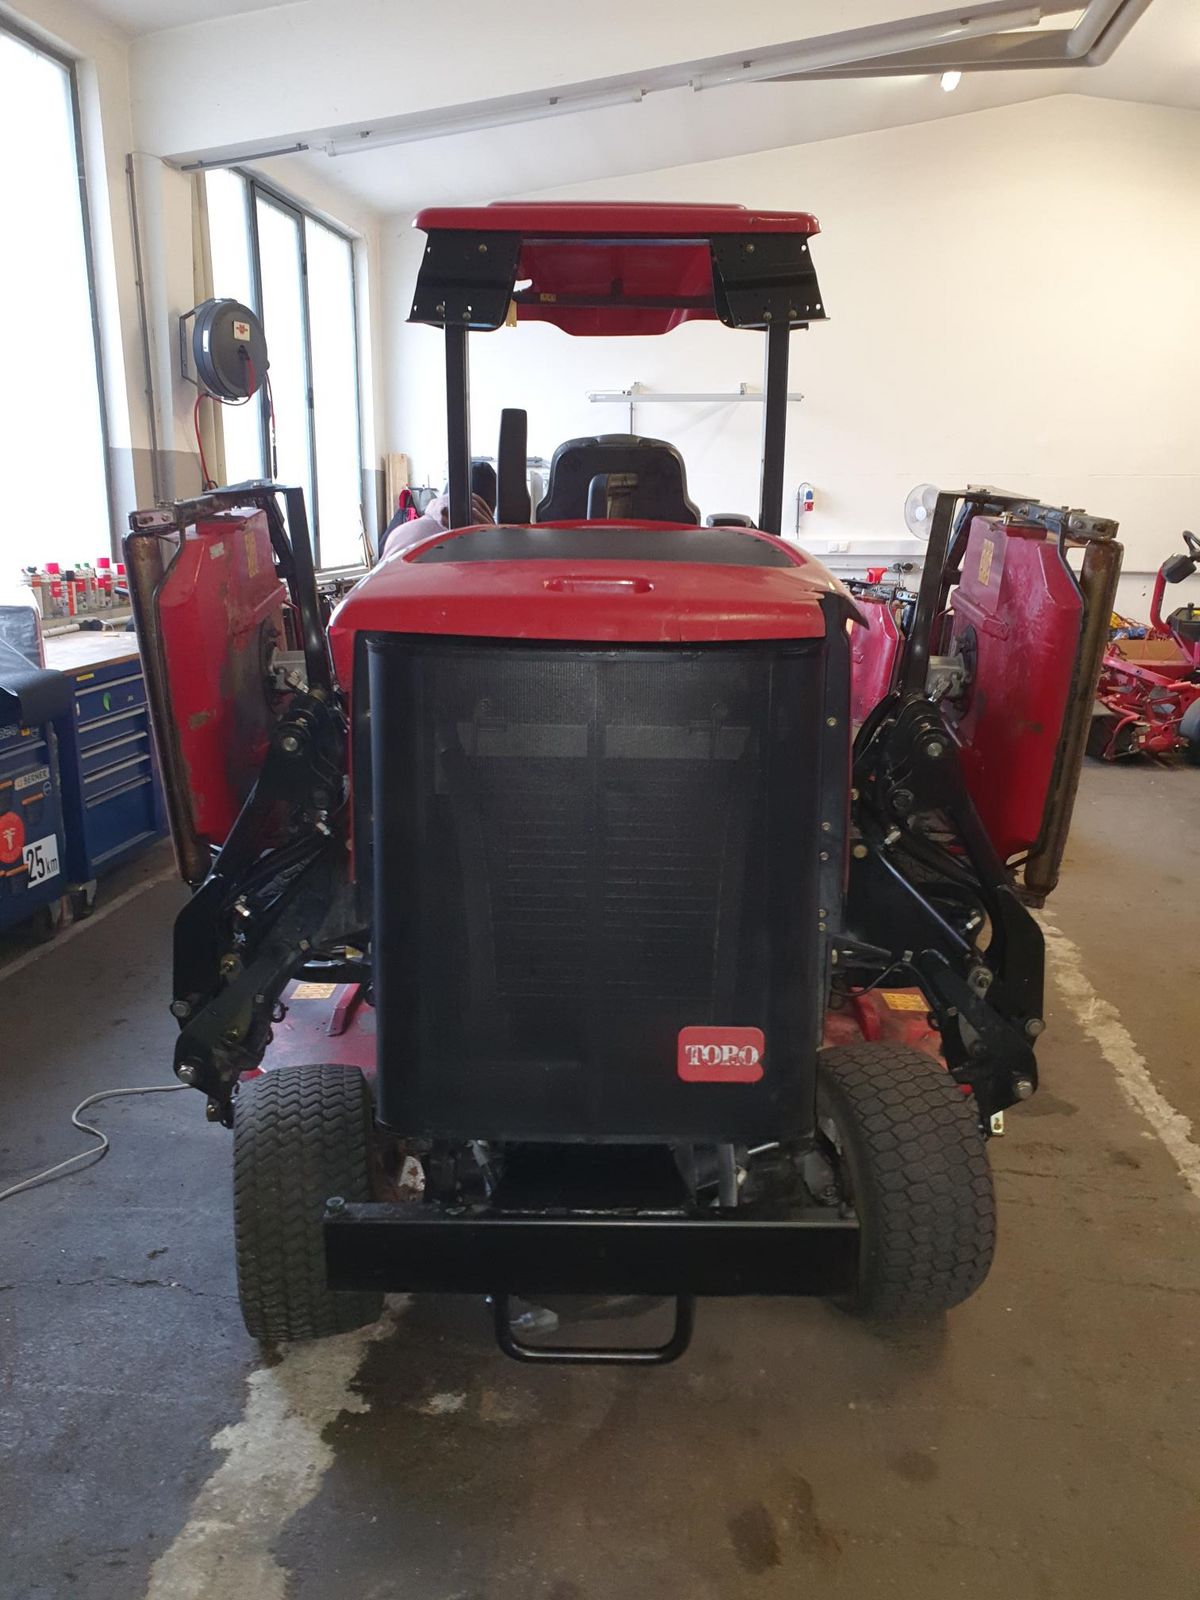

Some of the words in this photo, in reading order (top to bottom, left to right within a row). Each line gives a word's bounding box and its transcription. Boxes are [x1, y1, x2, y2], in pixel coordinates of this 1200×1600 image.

[23, 769, 48, 785] BERNER
[26, 845, 46, 882] 25
[45, 857, 58, 875] km
[684, 1044, 760, 1067] TORO
